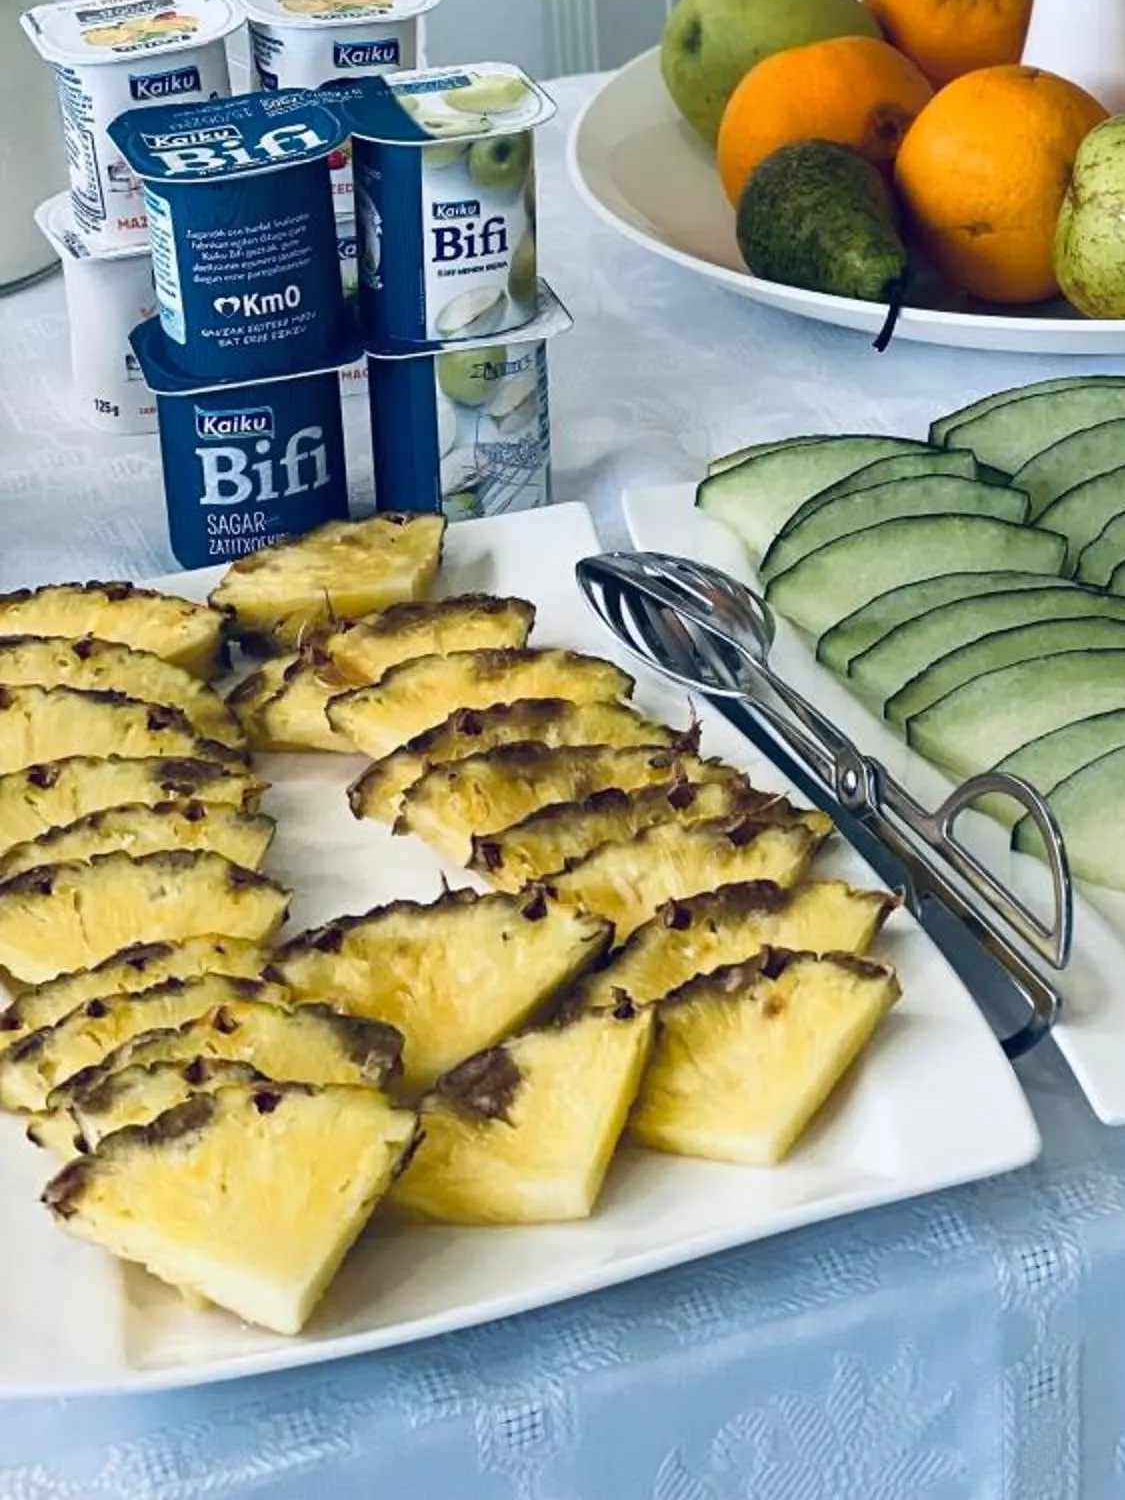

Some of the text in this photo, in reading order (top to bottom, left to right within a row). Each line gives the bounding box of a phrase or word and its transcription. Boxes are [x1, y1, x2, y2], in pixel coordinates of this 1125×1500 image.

[339, 46, 396, 65] Kaiku
[137, 73, 194, 99] Kaiku
[152, 123, 329, 176] Bifi
[154, 129, 230, 148] Kaiku
[437, 204, 477, 219] Kaiku
[432, 216, 509, 262] Bifi
[243, 285, 300, 317] Km0
[203, 415, 267, 434] Kaiku
[195, 425, 331, 506] Bifi
[207, 511, 266, 535] SAGAR
